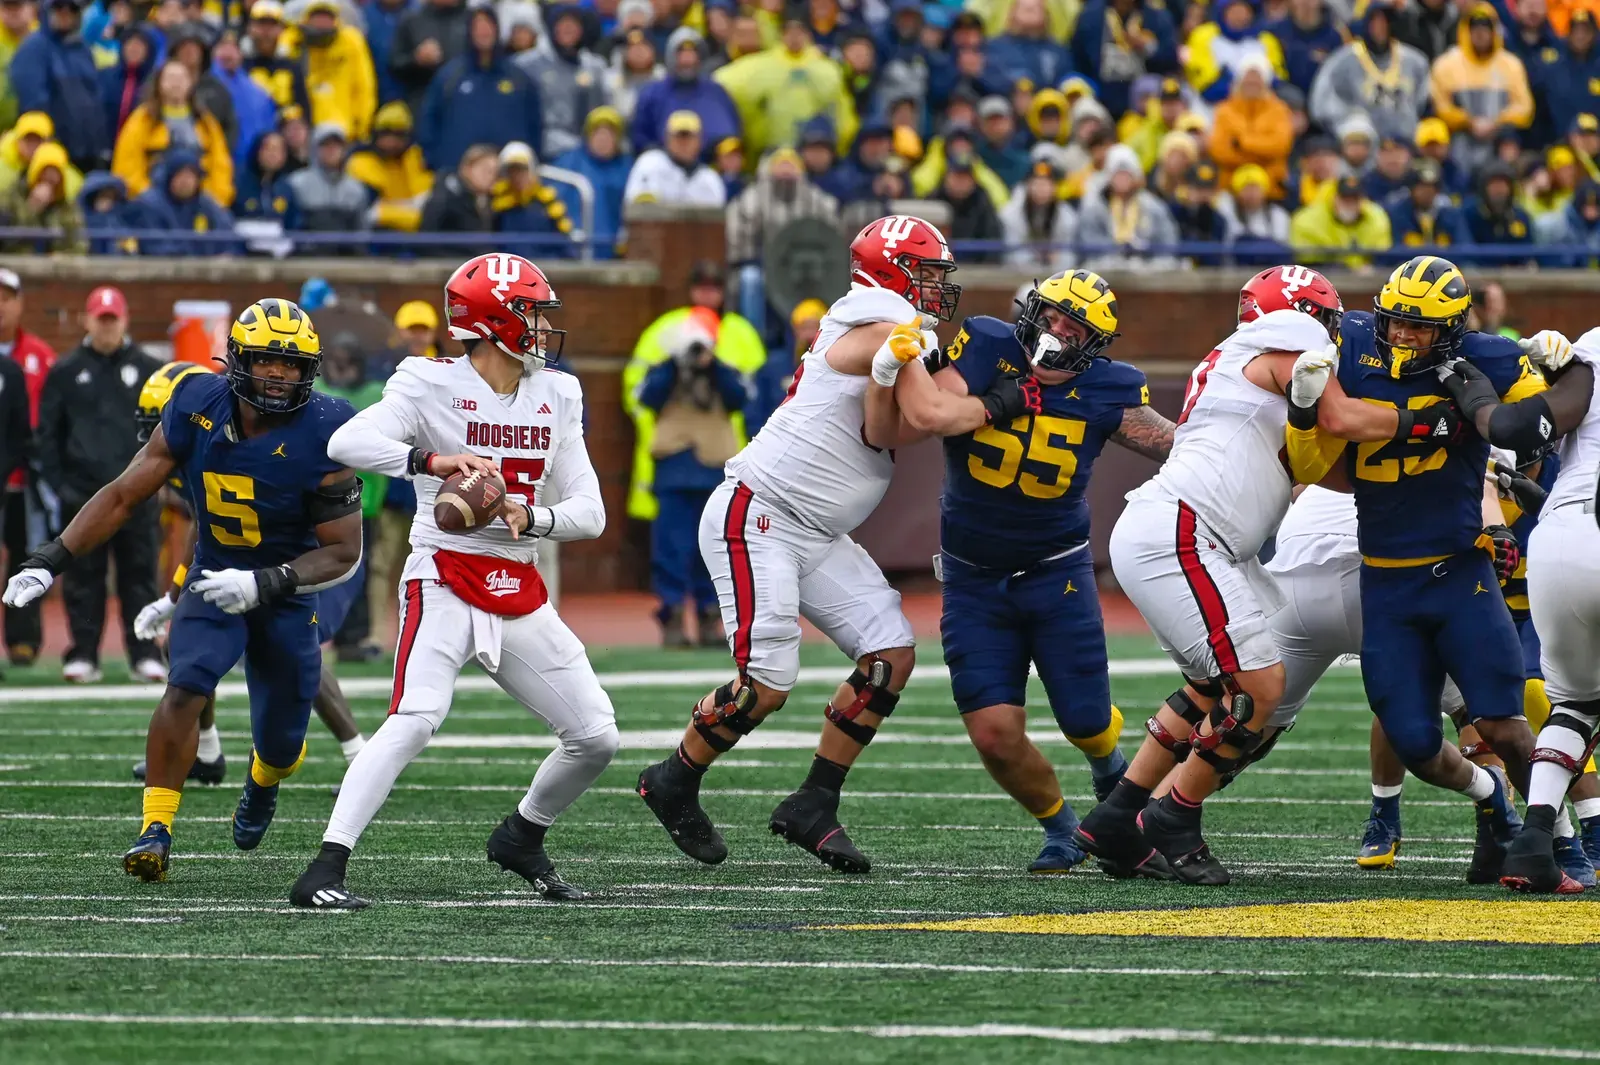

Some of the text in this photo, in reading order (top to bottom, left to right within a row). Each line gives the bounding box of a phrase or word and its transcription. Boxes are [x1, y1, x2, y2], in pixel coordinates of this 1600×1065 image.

[466, 421, 552, 451] HOOSIERS
[967, 414, 1087, 499] 55
[202, 471, 262, 548] 5
[475, 455, 545, 507] 5
